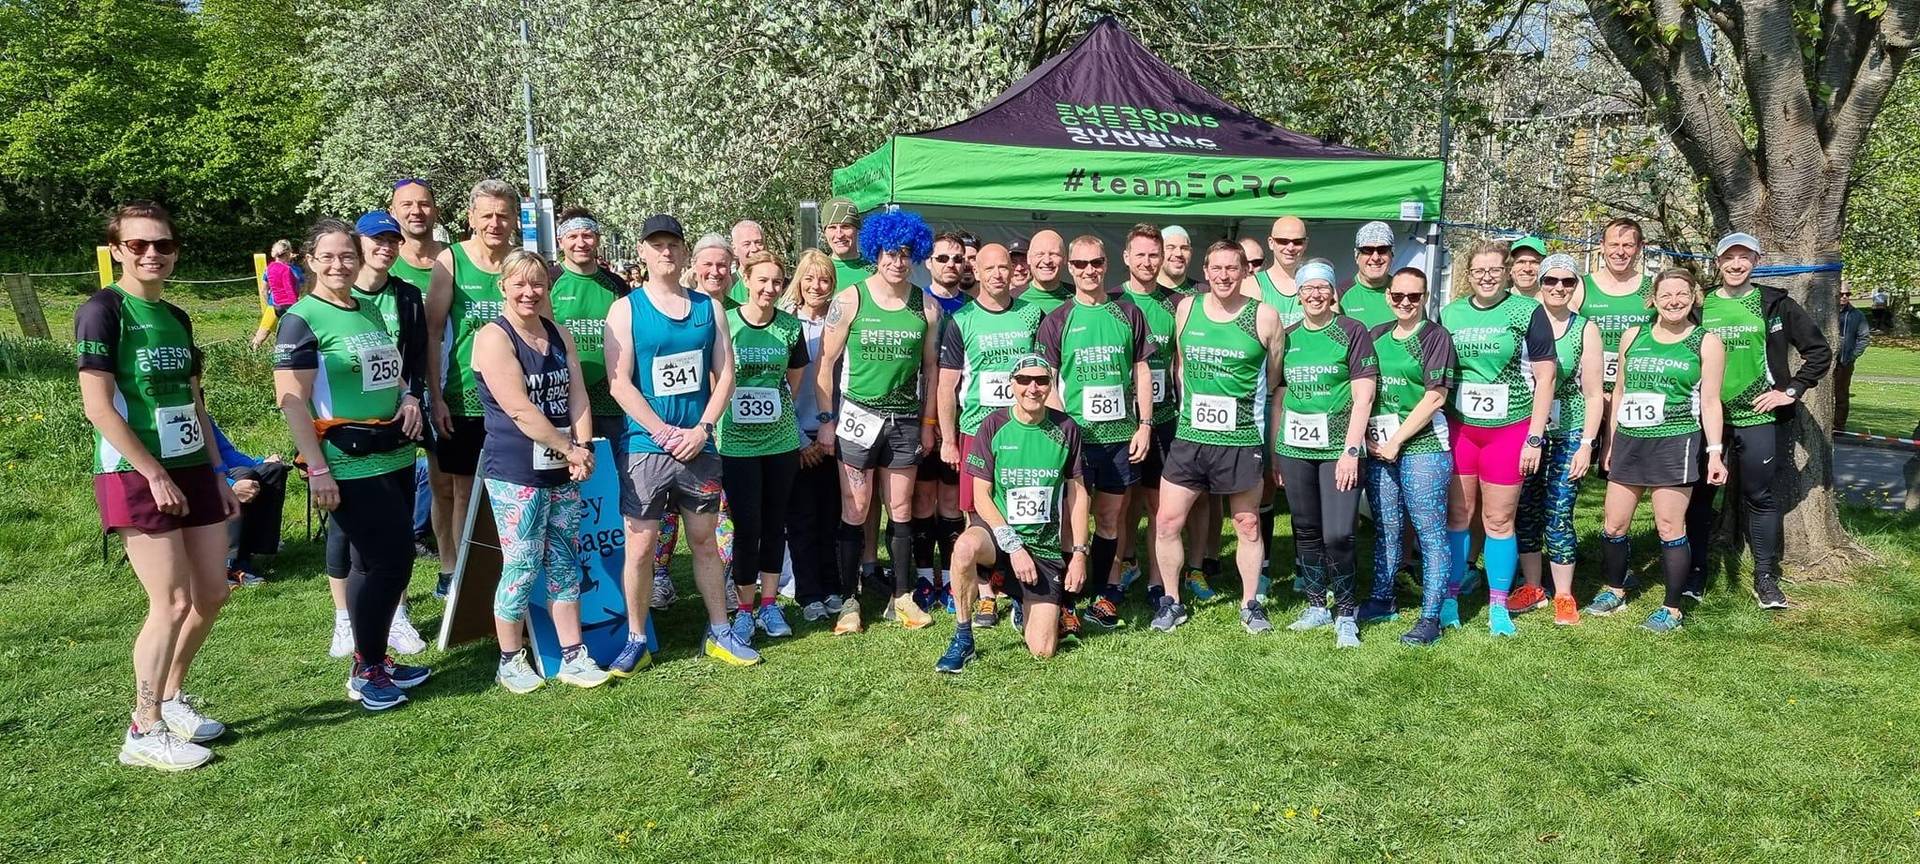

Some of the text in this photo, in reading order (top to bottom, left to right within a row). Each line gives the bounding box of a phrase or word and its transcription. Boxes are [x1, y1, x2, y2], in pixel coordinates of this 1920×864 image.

[1055, 103, 1220, 128] EMERSONS
[1060, 116, 1170, 134] GREEN
[1065, 127, 1217, 147] RUNNING
[465, 301, 505, 310] EMERS
[565, 319, 606, 327] EMERSO
[1590, 315, 1651, 323] EMERSONS
[1598, 322, 1630, 330] REEN
[860, 329, 922, 340] EMERSONS
[860, 337, 902, 346] GREEN
[136, 346, 192, 361] EMERSO
[861, 345, 913, 355] RUNNING
[980, 347, 1026, 357] RUNNING
[1185, 344, 1246, 359] EMERSONS
[1457, 342, 1500, 351] UNNING
[1459, 350, 1480, 358] LUB
[861, 353, 894, 361] CLUB
[1627, 356, 1690, 371] EMERSONS
[139, 360, 185, 372] GREEN
[371, 360, 399, 382] 258
[1285, 365, 1339, 376] EMERSONS
[1626, 364, 1665, 374] GREEN
[525, 367, 570, 390] MY TIME
[662, 365, 698, 388] 341
[546, 384, 570, 401] SPAC
[549, 399, 569, 415] PAC
[739, 400, 775, 417] 339
[1091, 398, 1120, 415] 581
[1471, 397, 1494, 412] 73
[1196, 407, 1228, 424] 650
[1625, 405, 1656, 420] 113
[843, 418, 866, 438] 96
[1292, 427, 1321, 441] 124
[1000, 468, 1060, 478] EMERSONS
[1000, 477, 1040, 486] GREEN
[580, 496, 603, 525] ey
[1016, 500, 1046, 517] 534
